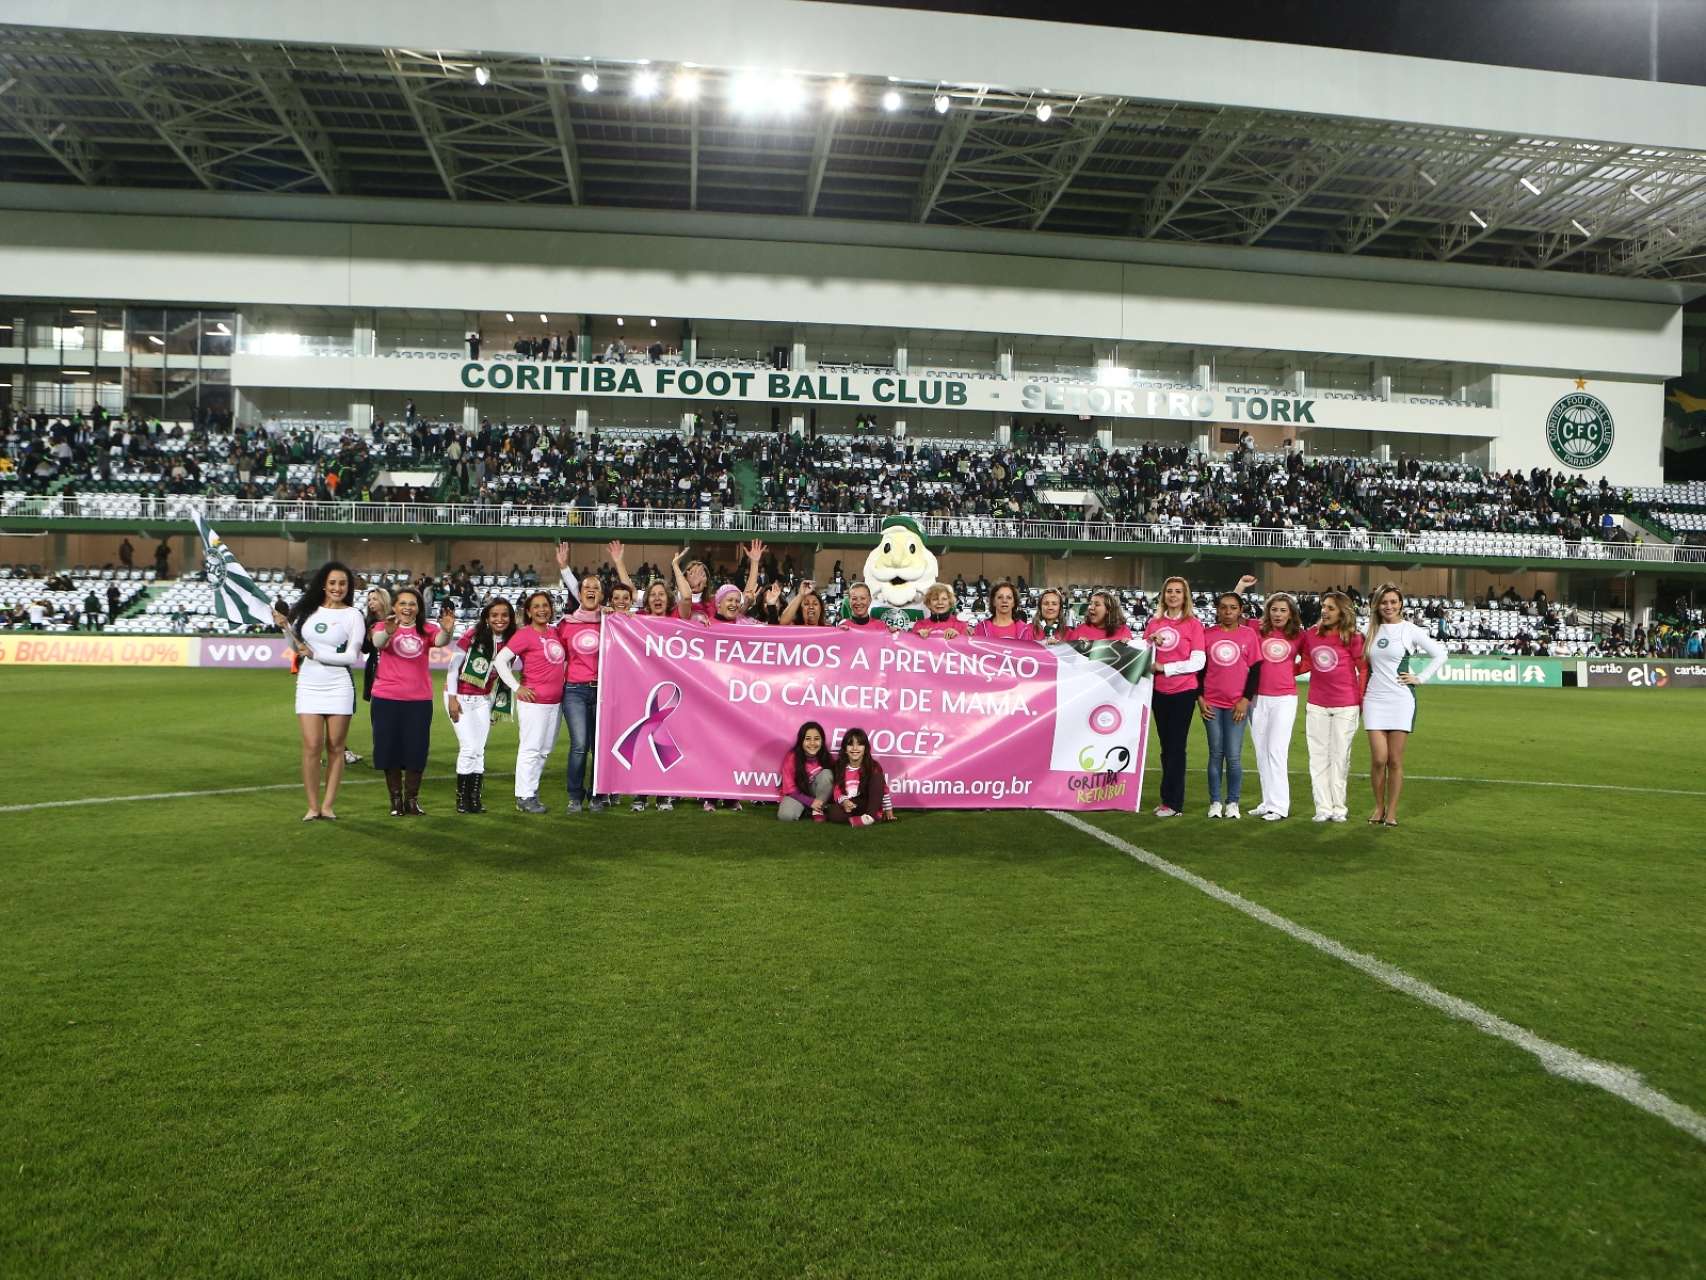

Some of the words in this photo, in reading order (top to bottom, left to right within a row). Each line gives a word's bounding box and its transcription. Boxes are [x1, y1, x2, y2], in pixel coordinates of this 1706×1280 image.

[460, 362, 643, 393] CORITIBA
[656, 368, 756, 397] FOOT
[767, 373, 861, 402] BALL
[872, 377, 968, 406] CLUB
[1021, 384, 1136, 415] SETOR
[1146, 391, 1215, 418] PRO
[1224, 395, 1316, 424] TORK
[1562, 422, 1598, 440] CFC
[14, 640, 114, 662] BRAHMA
[645, 630, 705, 661] NÓS
[714, 639, 841, 669] FAZEMOS
[850, 647, 870, 670] A
[879, 647, 1040, 683] PREVENÇÃO
[1437, 663, 1517, 682] Unimed
[728, 679, 772, 704] DO
[781, 678, 889, 711] CÂNCER
[900, 688, 933, 712] DE
[941, 690, 1038, 717] MAMA.
[868, 725, 945, 755] OCÊ?
